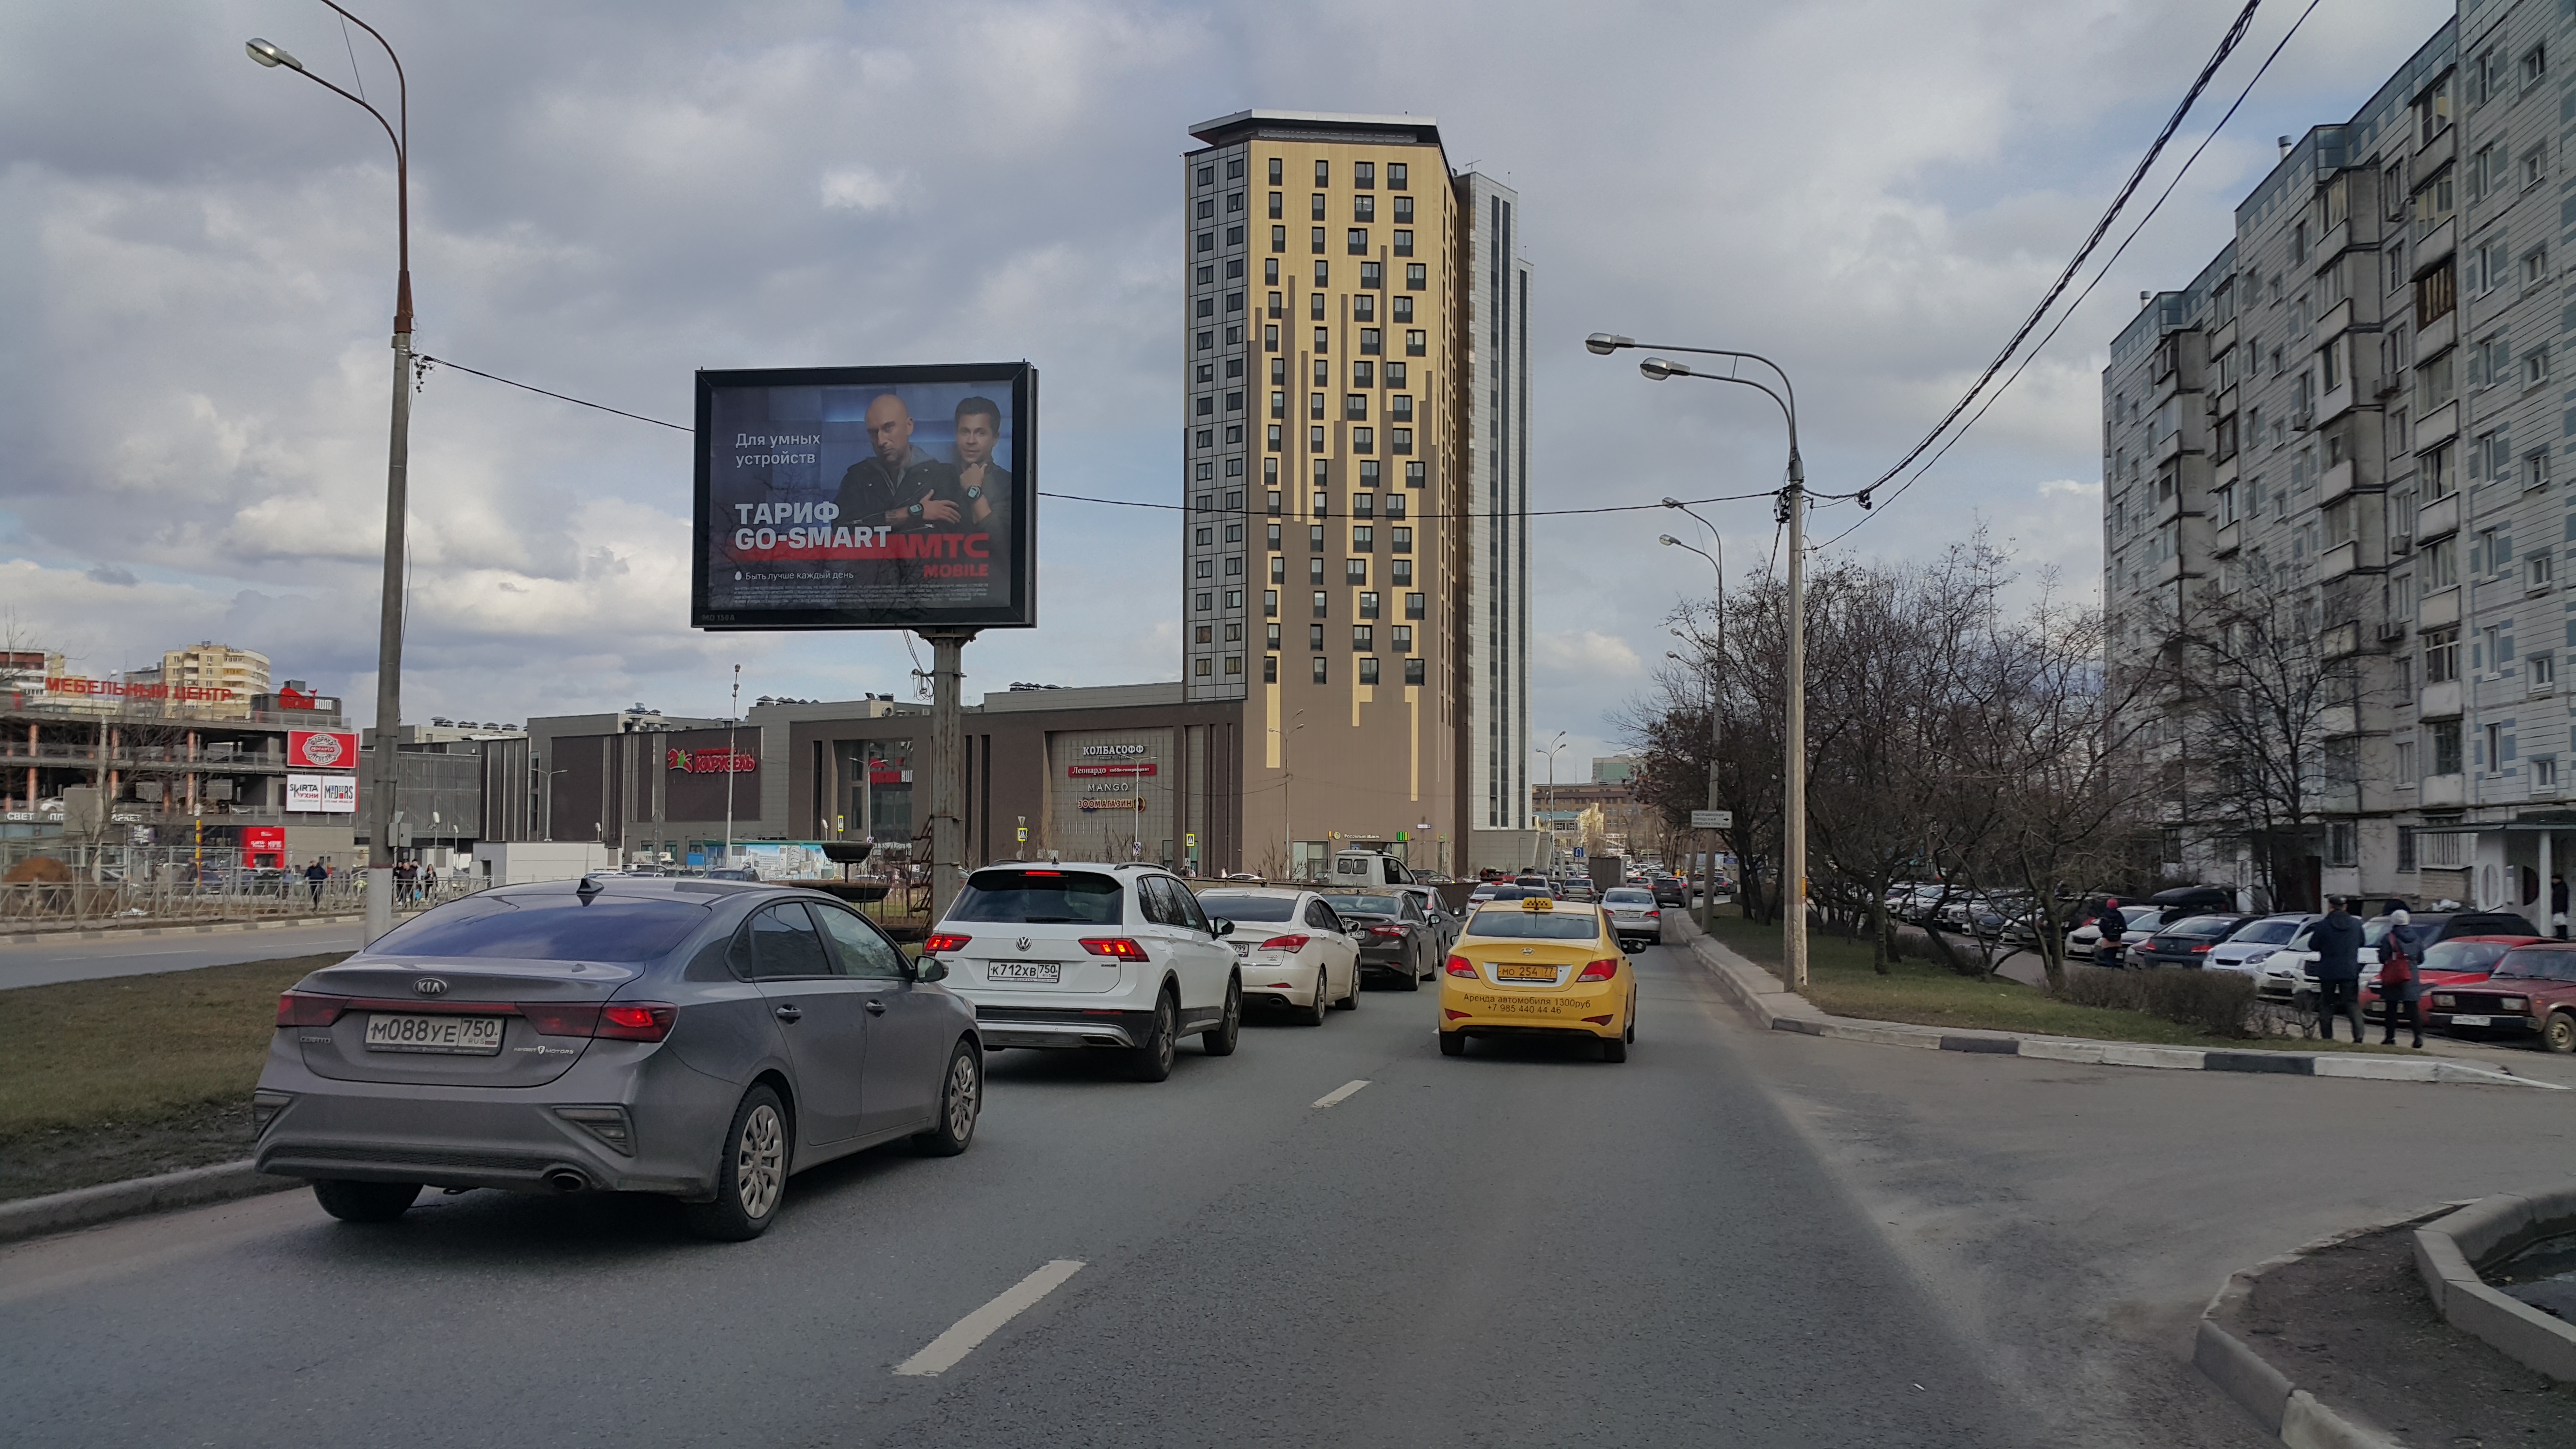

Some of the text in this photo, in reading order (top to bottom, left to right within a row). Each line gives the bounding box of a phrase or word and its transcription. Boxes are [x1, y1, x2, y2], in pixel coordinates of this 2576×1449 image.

[735, 433, 821, 449] Для умных
[735, 451, 816, 468] устройств
[735, 501, 839, 525] ТАРИФ
[735, 526, 892, 550] GO-SMART
[768, 572, 794, 581] лучше
[797, 570, 830, 580] каждый
[832, 572, 854, 580] день
[924, 564, 989, 578] MOBILE
[45, 677, 232, 702] МЕБЕЛЬНЫЙ ЦЕНТР
[1083, 745, 1144, 756] КОЛБАСОФФ
[1072, 766, 1107, 775] Леонардо
[1088, 783, 1128, 792] MANGO
[1078, 799, 1133, 809] ЗООМАГАЗИН
[6, 812, 34, 821] СВЕТ
[992, 964, 1056, 977] К712ХВ 750
[1519, 967, 1538, 976] 254
[417, 981, 441, 993] KIA
[1464, 993, 1591, 1009] Аренда автомобиля 1300руб
[1500, 1004, 1516, 1013] 985
[1551, 1006, 1562, 1014] 46
[371, 1018, 495, 1043] М088УЕ 750
